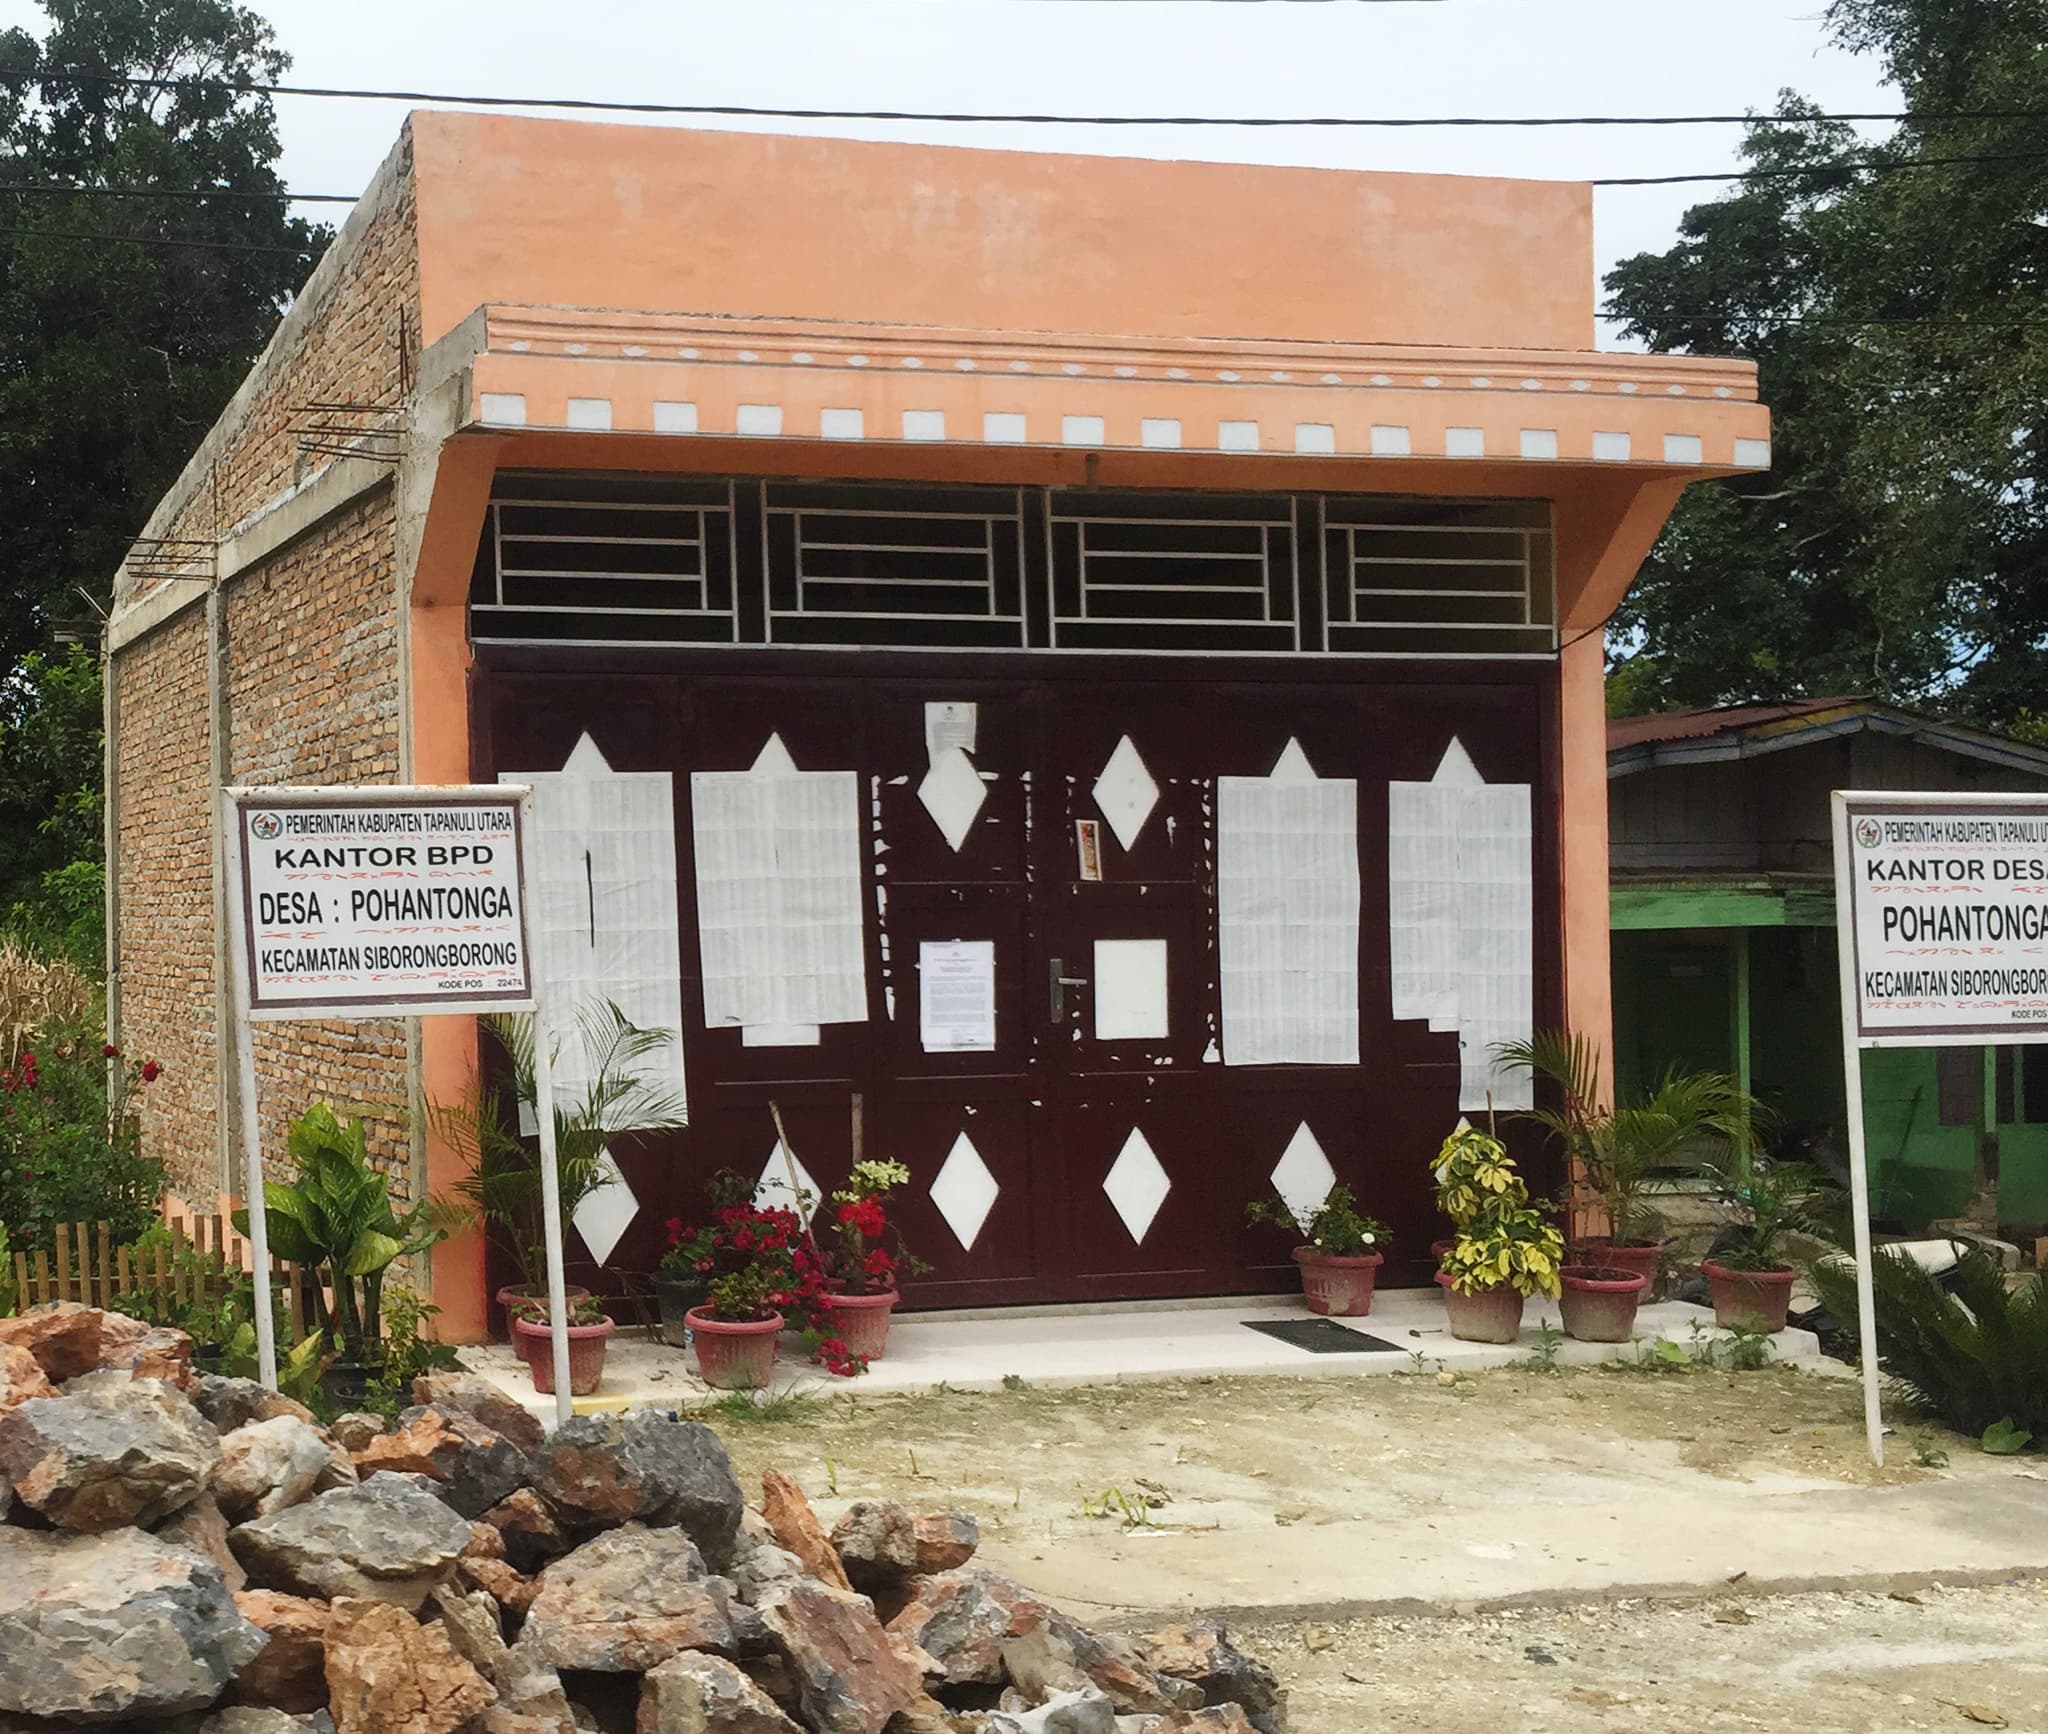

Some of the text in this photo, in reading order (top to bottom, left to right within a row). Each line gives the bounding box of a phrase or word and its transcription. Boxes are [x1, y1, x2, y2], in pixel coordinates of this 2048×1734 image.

[286, 812, 512, 834] PEMERINTAH KABUPATEN TAPANULI UTARA
[1885, 821, 1943, 842] PEMERINTAH
[1944, 821, 1997, 842] KABUPATEN
[1998, 822, 2039, 842] TAPANULI
[275, 845, 493, 869] KANTOR BPD
[1868, 859, 2048, 881] KANTOR DES
[260, 891, 323, 925] DESA
[351, 886, 513, 922] POHANTONGA
[1883, 905, 2048, 942] POHANTONGA
[262, 942, 517, 973] KECAMATAN SIBORONGBORONG
[438, 980, 463, 989] KODE
[464, 979, 483, 988] POS
[1866, 968, 2048, 998] KECAMATAN SIBORONGBOR
[2011, 1009, 2048, 1019] KODE POS
